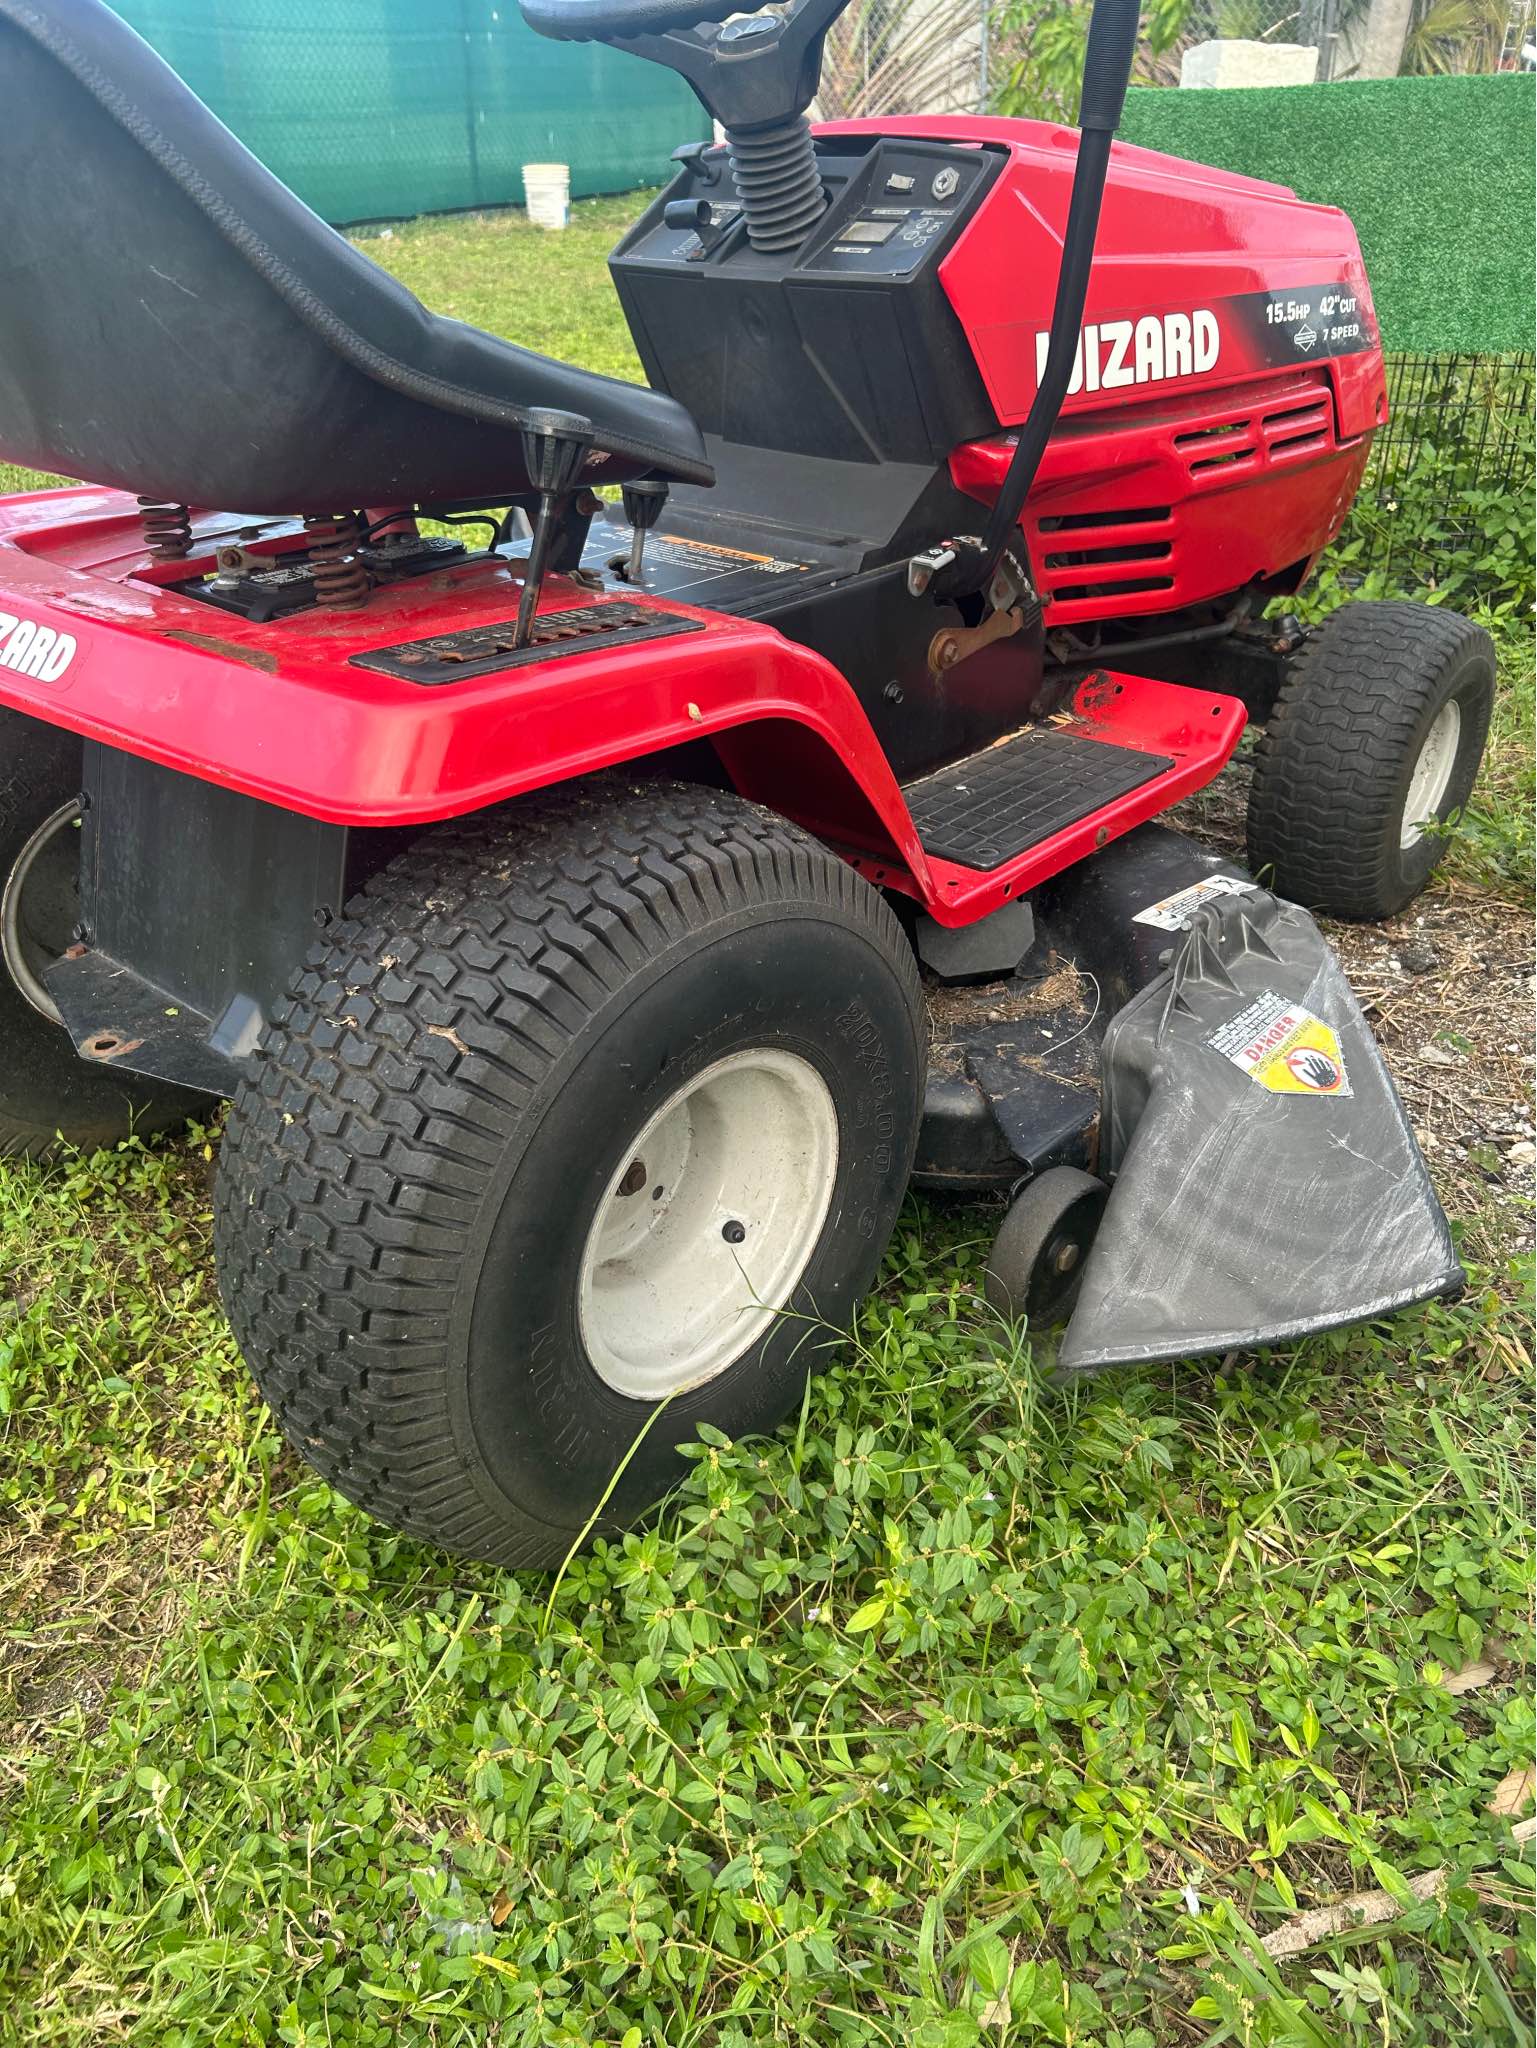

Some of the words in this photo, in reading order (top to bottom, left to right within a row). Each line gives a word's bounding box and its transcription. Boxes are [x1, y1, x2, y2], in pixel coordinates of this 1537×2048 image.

[1266, 301, 1310, 324] 15.5HP
[1323, 328, 1329, 341] 7
[1331, 324, 1360, 341] SPEED
[1243, 1016, 1297, 1062] DANGER
